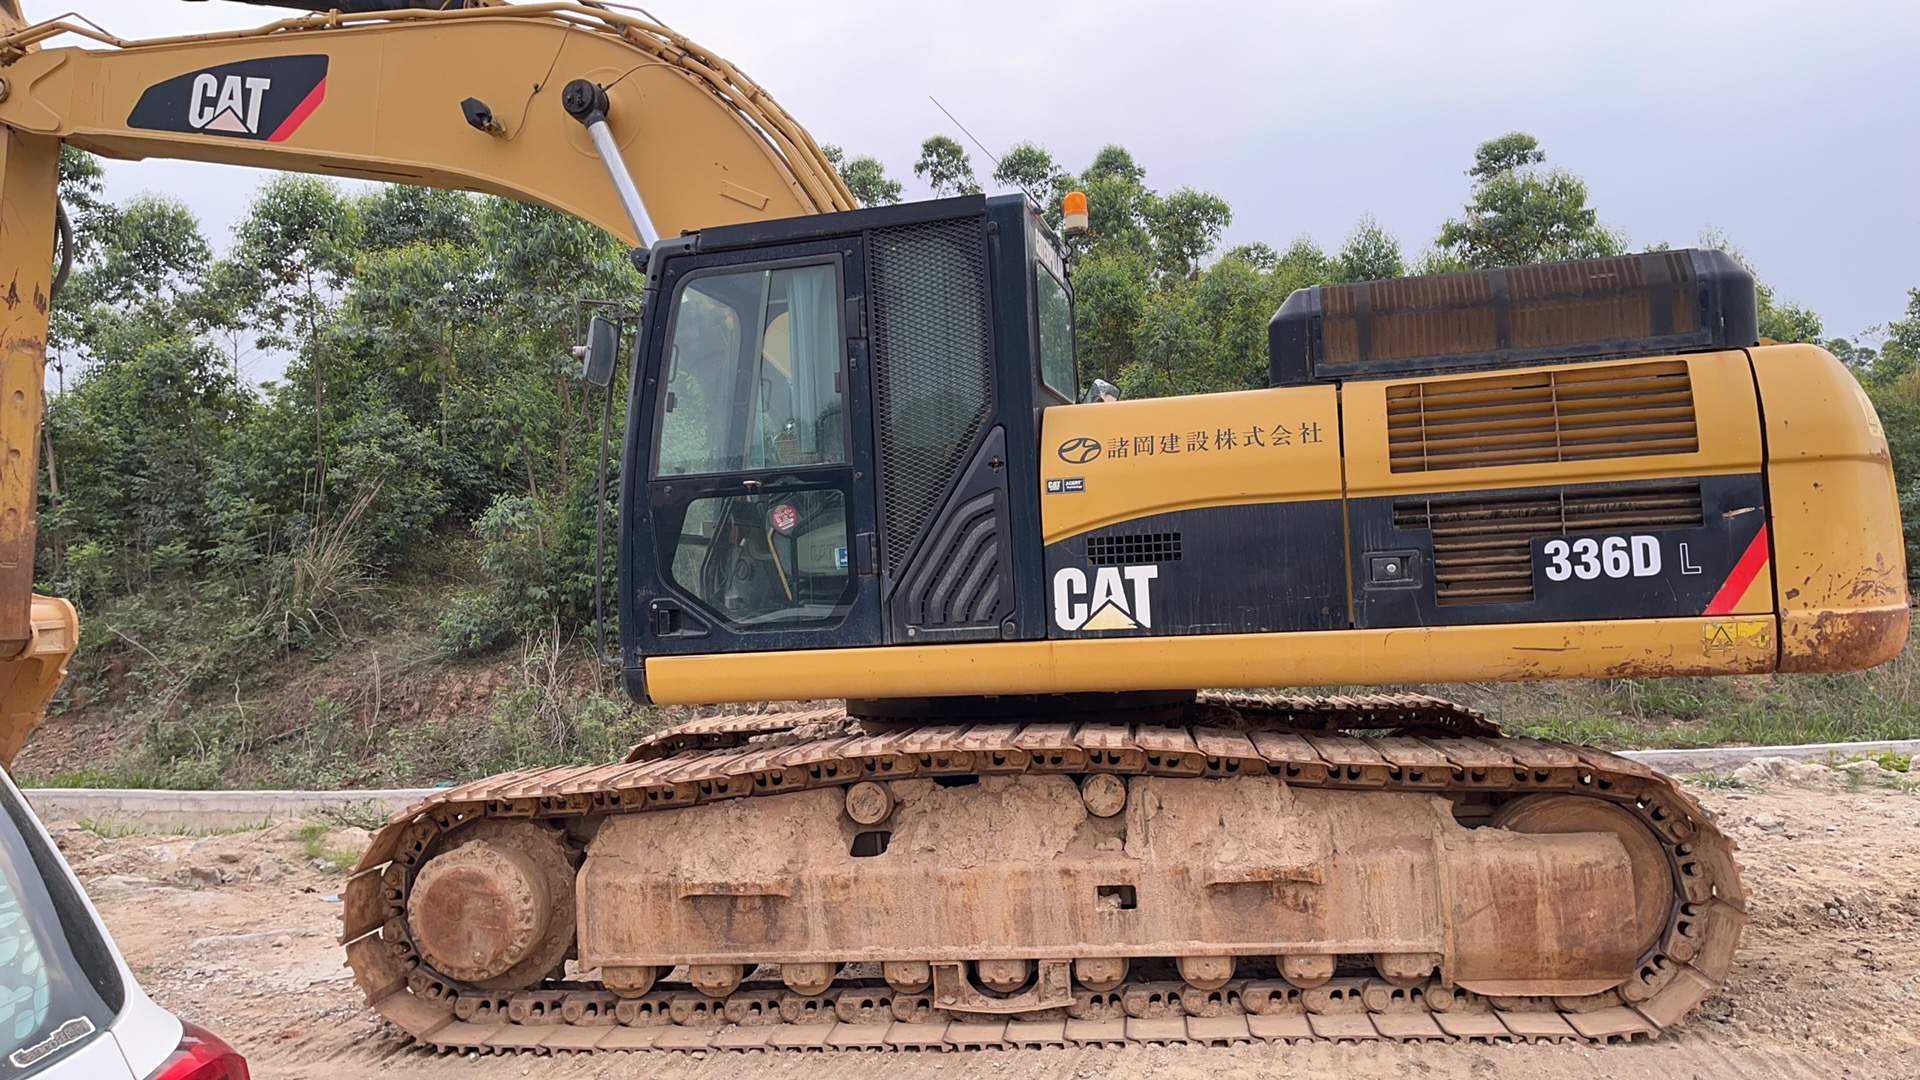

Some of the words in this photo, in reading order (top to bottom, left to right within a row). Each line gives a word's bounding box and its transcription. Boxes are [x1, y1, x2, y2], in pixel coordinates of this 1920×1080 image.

[189, 73, 271, 134] CAT
[1107, 422, 1323, 459] 諸岡建設株式会社
[1047, 480, 1061, 490] CAT
[1543, 535, 1662, 581] 336D
[1679, 543, 1702, 575] L
[1053, 564, 1158, 631] CAT
